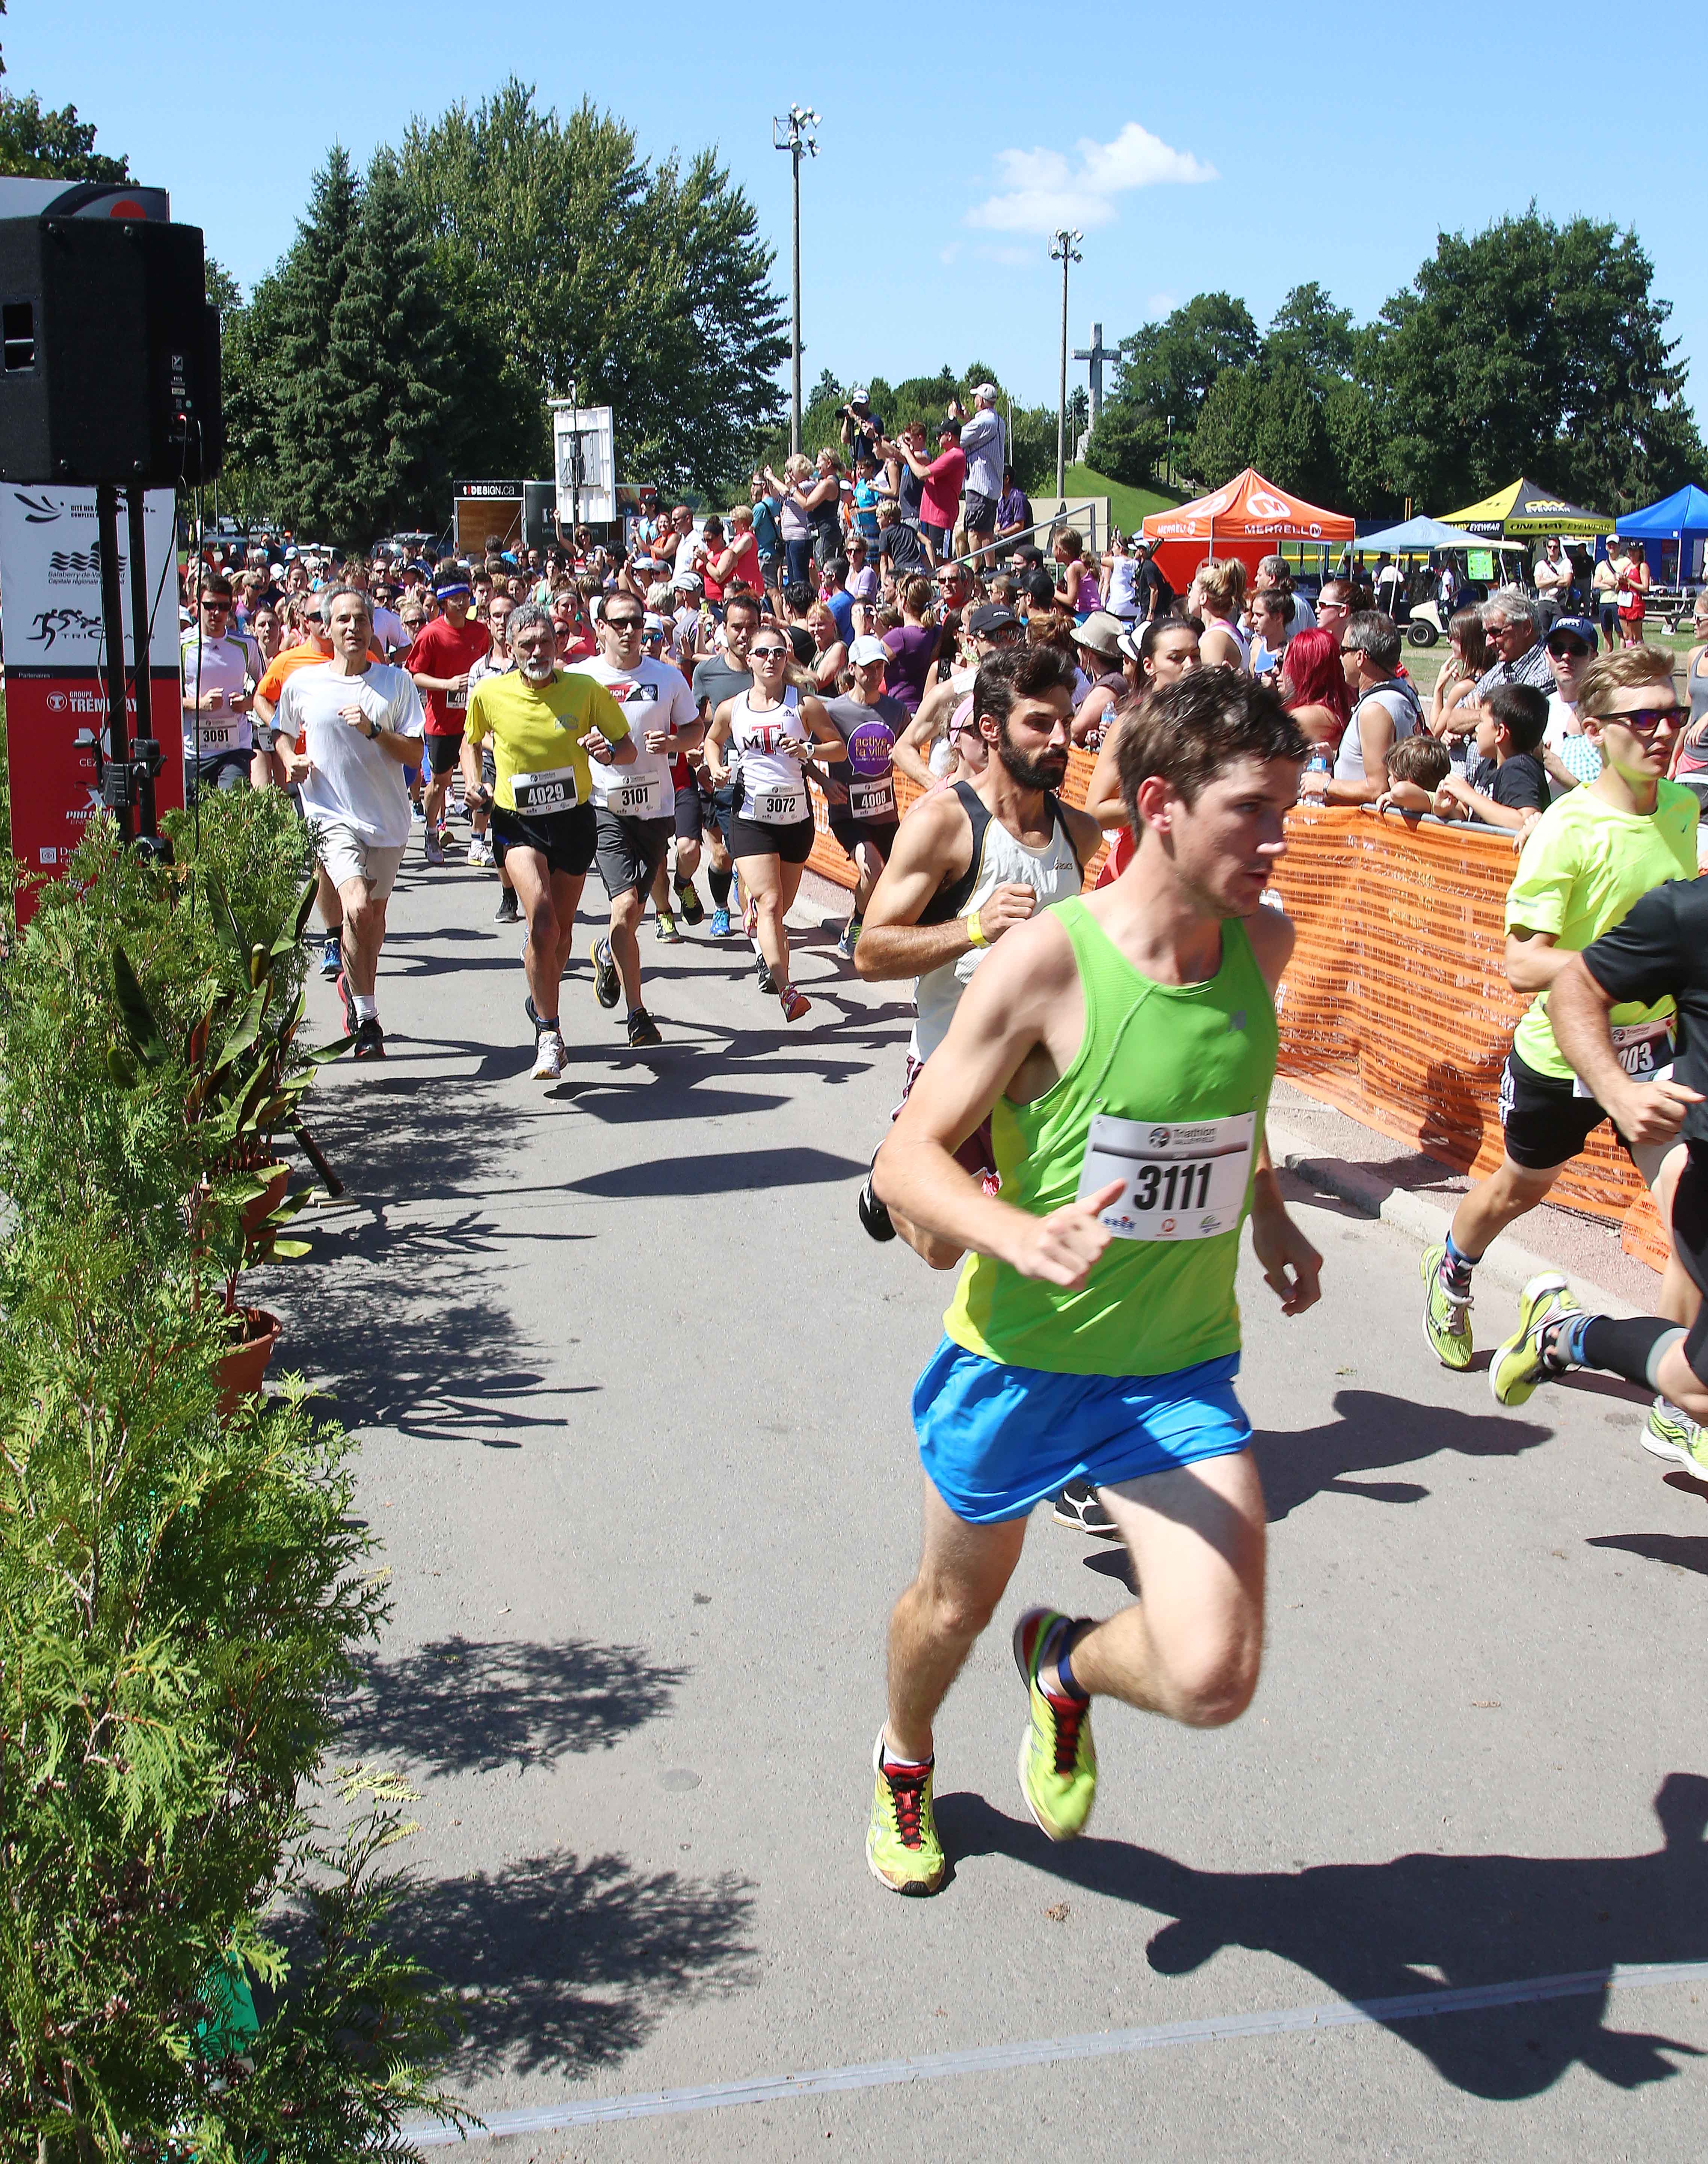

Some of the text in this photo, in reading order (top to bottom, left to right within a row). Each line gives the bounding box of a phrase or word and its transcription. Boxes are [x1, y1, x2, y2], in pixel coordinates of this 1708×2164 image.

[1244, 523, 1310, 535] MERRELL
[1469, 523, 1500, 532] EYEWEAR
[70, 698, 137, 713] TREMAY
[203, 729, 228, 742] 3091
[855, 735, 887, 747] active
[528, 783, 564, 805] 4029
[622, 787, 648, 806] 3101
[862, 790, 886, 808] 4008
[767, 798, 796, 812] 3072
[1172, 1127, 1217, 1138] Triathlon
[1134, 1162, 1214, 1210] 3111
